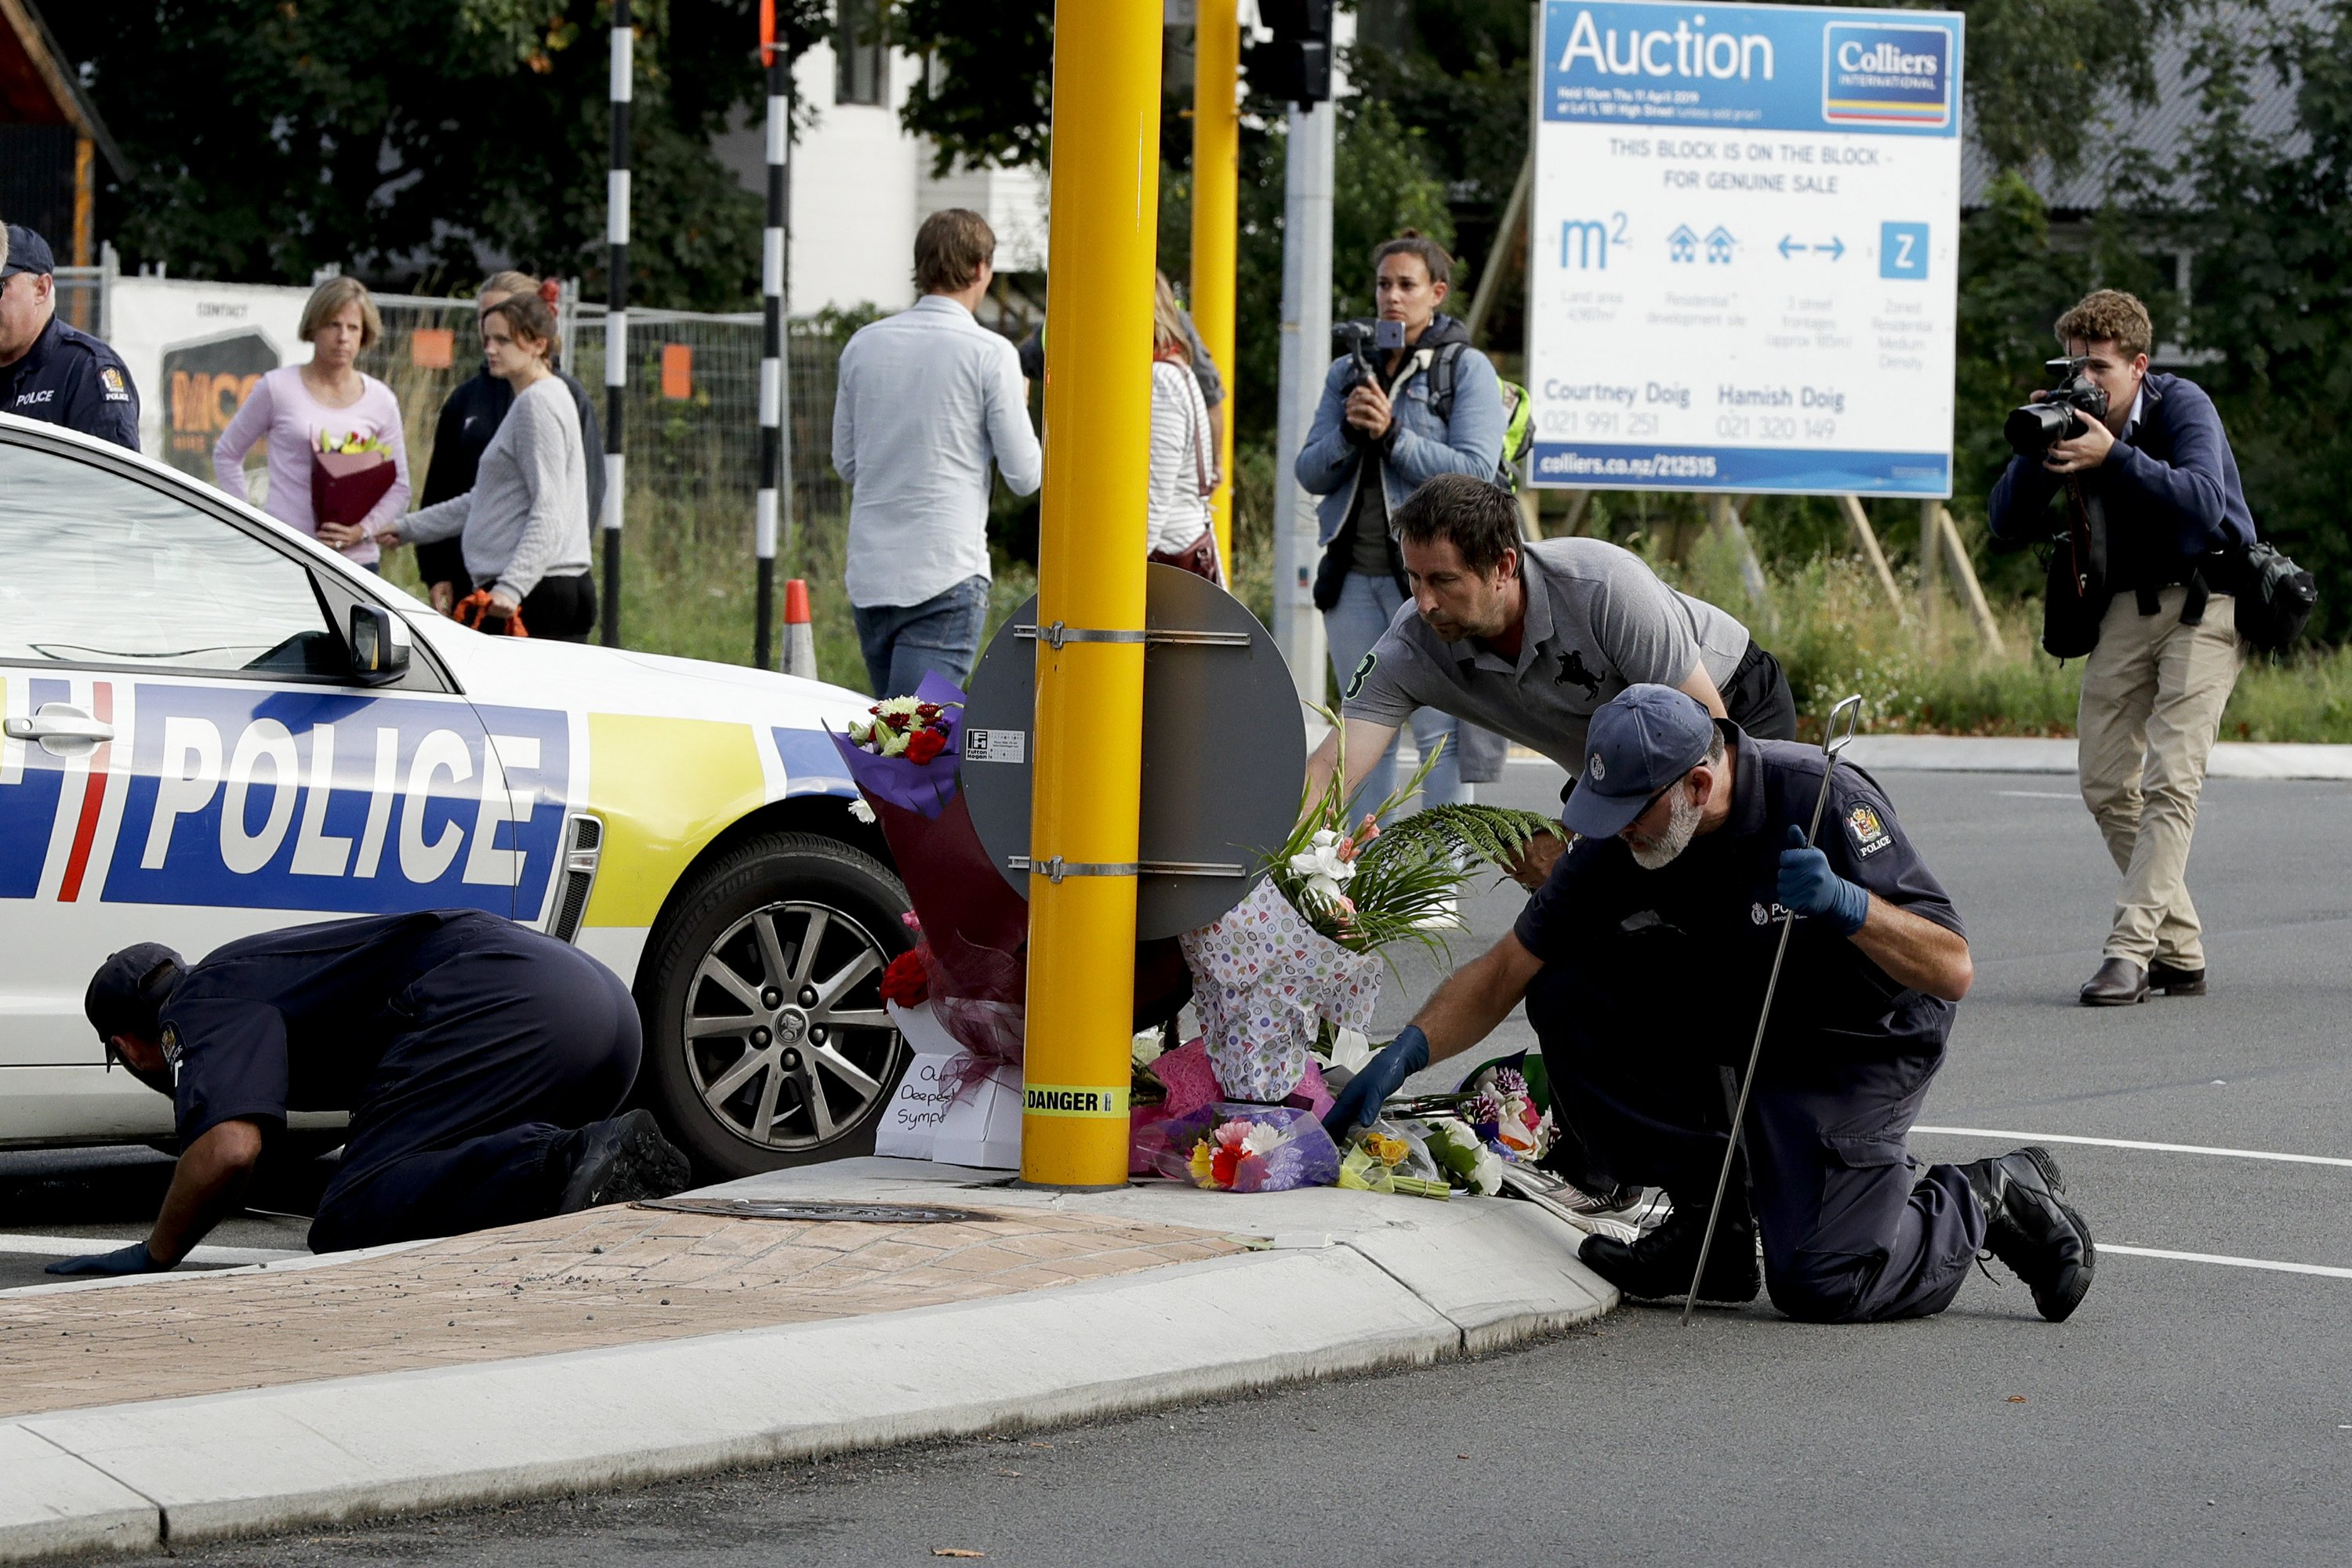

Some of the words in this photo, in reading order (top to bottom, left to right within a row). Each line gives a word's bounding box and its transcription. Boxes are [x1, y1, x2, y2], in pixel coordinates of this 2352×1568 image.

[1559, 10, 1774, 80] Auction
[1838, 41, 1937, 75] Colliers
[1838, 74, 1936, 90] INTERNATIONAL
[1610, 138, 1650, 156] THIS
[1657, 140, 1716, 158] BLOCK
[1724, 143, 1740, 159] IS
[1746, 143, 1773, 161] ON
[1780, 145, 1814, 163] THE
[1821, 147, 1879, 165] BLOCK
[1664, 170, 1700, 189] FOR
[1706, 172, 1785, 192] GENUINE
[1792, 175, 1838, 194] SALE
[1895, 234, 1914, 268] Z
[198, 302, 249, 318] CONTACT
[16, 390, 55, 407] POLICE
[105, 393, 129, 402] POLICE
[1544, 379, 1637, 408] Courtney
[1646, 381, 1691, 410] Doig
[1718, 384, 1793, 408] Hamish
[1802, 387, 1846, 413] Doig
[1543, 409, 1578, 434] 021
[1585, 412, 1620, 435] 991
[1627, 412, 1660, 437] 251
[1715, 415, 1751, 439] 021
[1759, 416, 1798, 441] 320
[1804, 417, 1837, 441] 149
[140, 716, 542, 886] POLICE
[1860, 835, 1891, 857] POLICE
[1028, 1090, 1098, 1111] DANGER
[898, 1109, 946, 1131] Sympa
